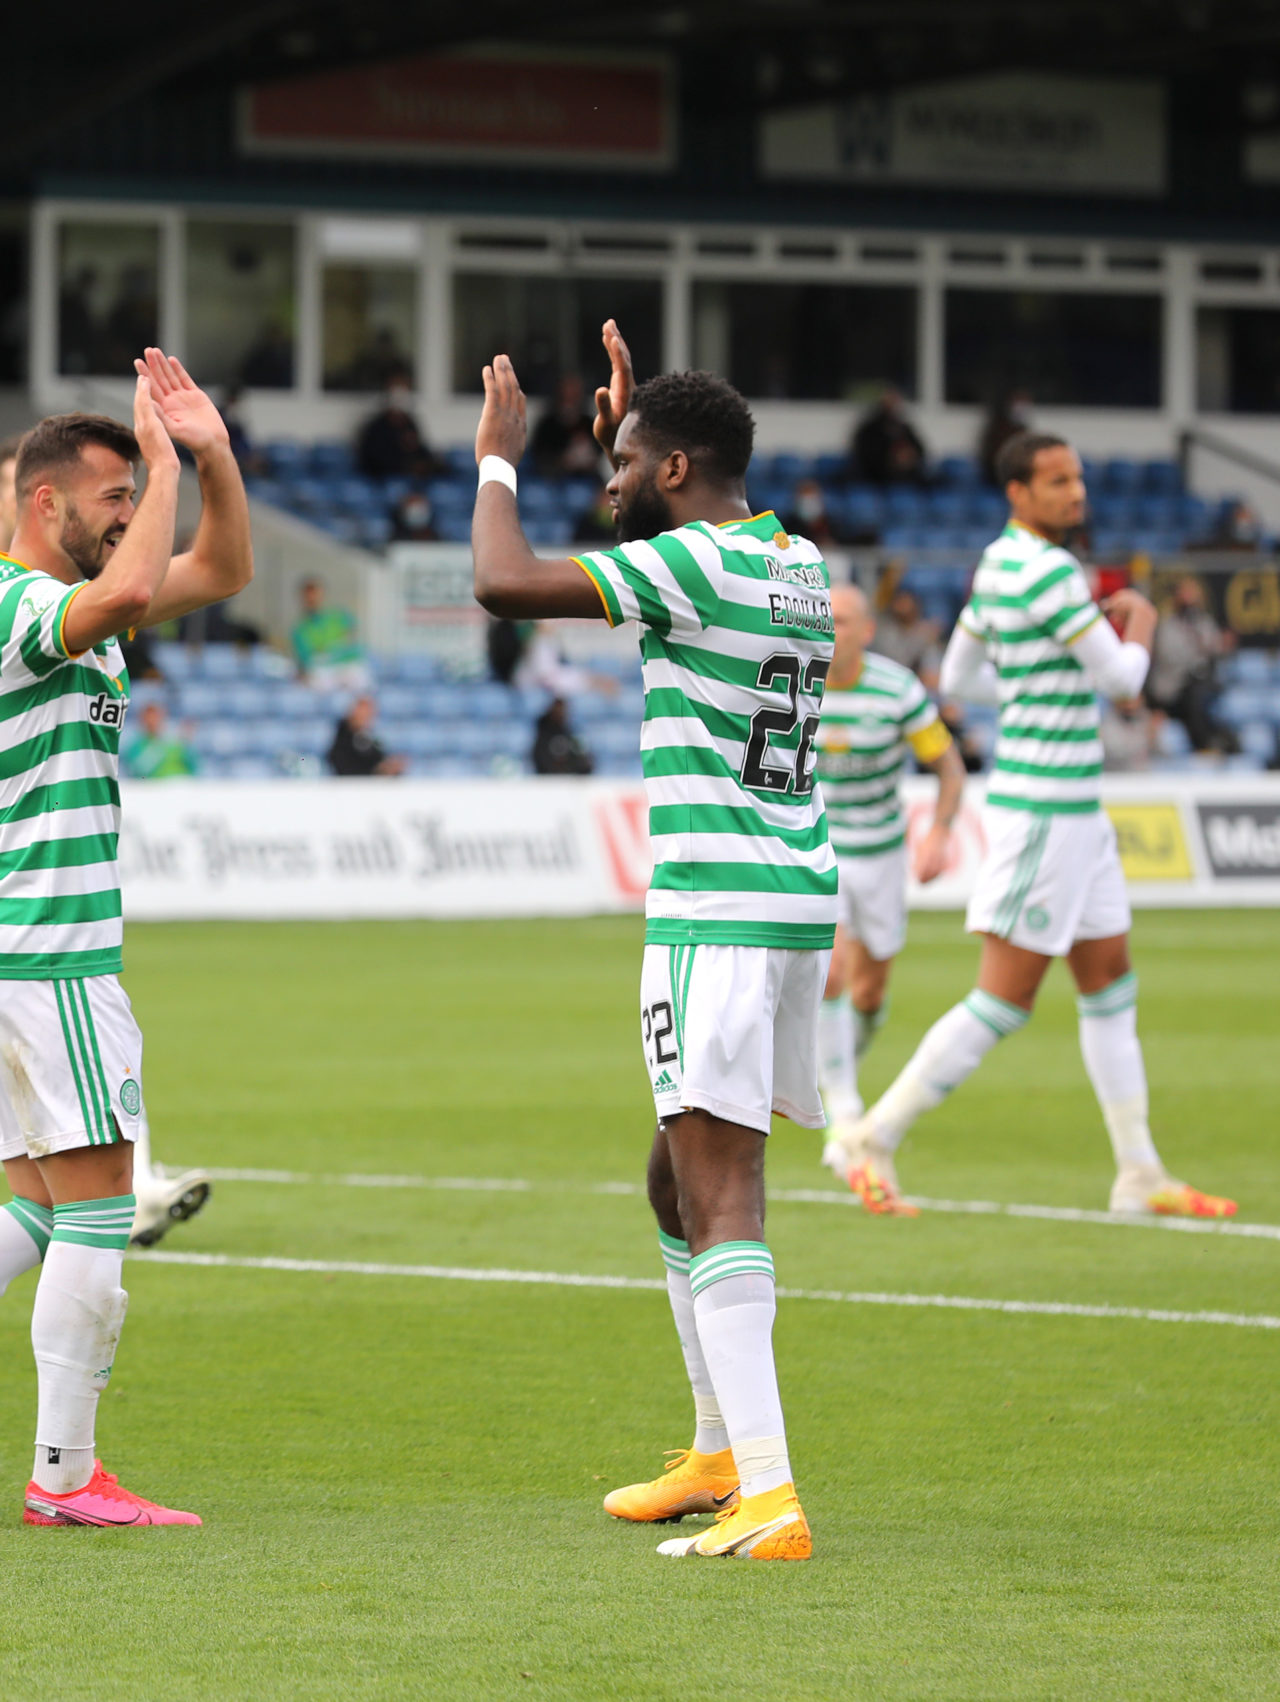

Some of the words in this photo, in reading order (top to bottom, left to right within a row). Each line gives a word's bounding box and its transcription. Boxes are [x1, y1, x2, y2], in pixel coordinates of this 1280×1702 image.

[769, 592, 835, 632] EDOUAR
[740, 652, 832, 795] 22
[328, 811, 406, 879] and
[653, 1082, 678, 1095] adidas
